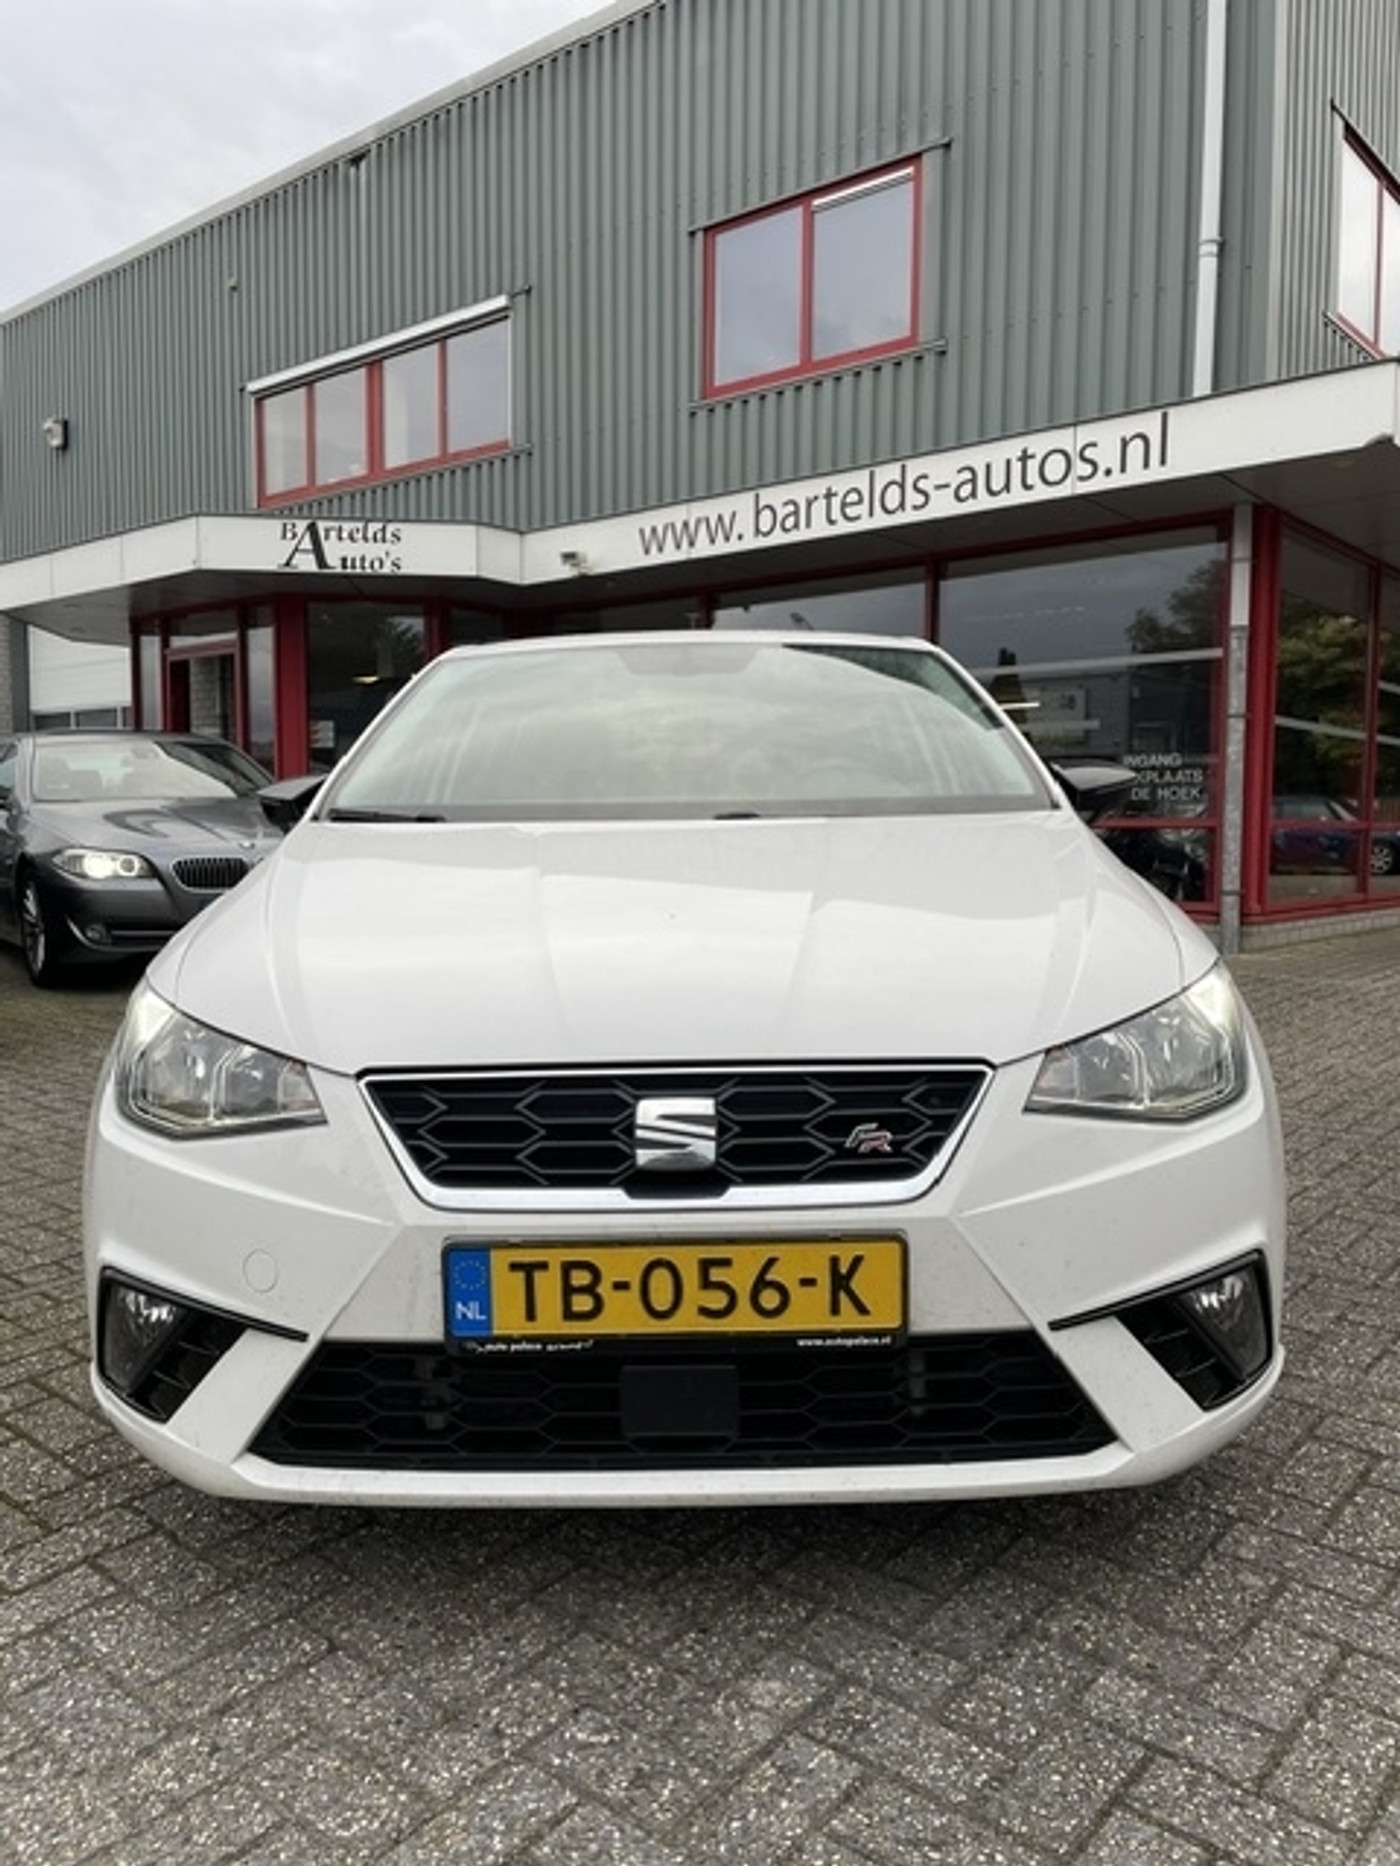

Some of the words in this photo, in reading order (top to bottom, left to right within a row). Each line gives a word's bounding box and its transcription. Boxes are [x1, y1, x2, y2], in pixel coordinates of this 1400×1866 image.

[638, 411, 1169, 556] www.bartelds-autos.nl
[1123, 753, 1182, 768] INGANG
[1134, 769, 1203, 784] KPLAATS
[1131, 787, 1150, 800] DE
[1157, 786, 1202, 800] HOEK
[508, 1254, 871, 1323] TB-056-K
[455, 1301, 487, 1320] NL
